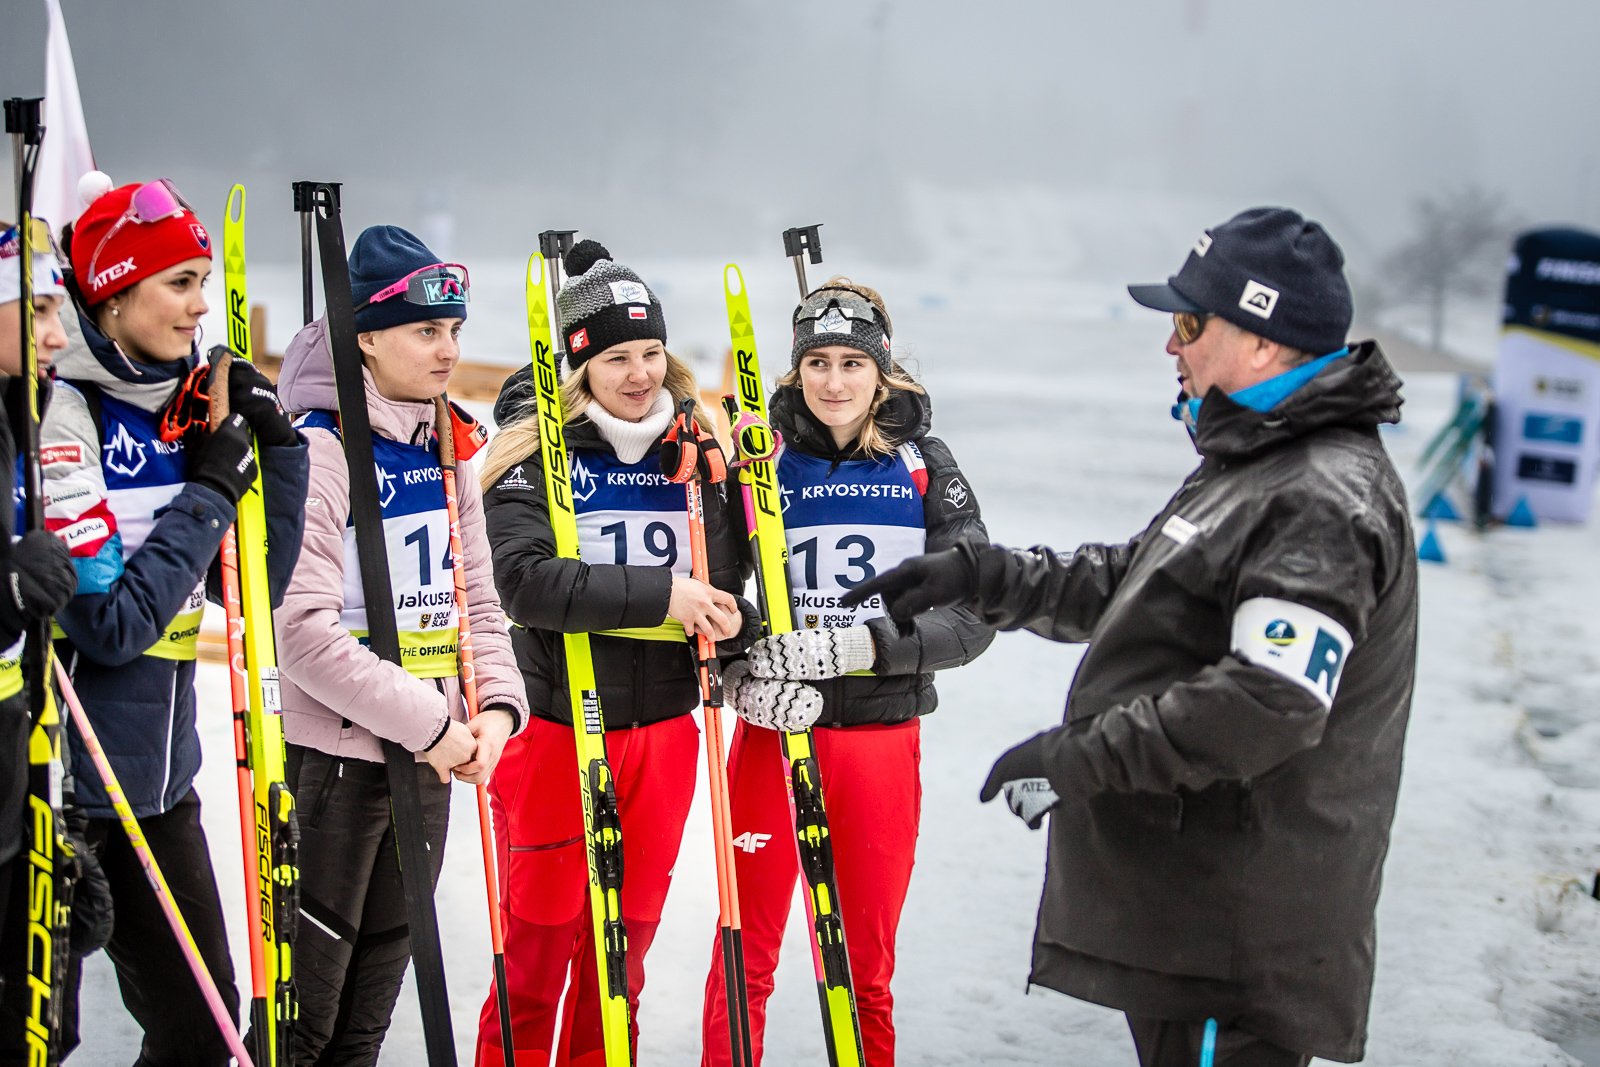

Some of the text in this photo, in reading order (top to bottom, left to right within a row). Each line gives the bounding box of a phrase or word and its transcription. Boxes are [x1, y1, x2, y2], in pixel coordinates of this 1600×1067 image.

[535, 339, 571, 514] FISCHER
[403, 466, 443, 486] KRYOS
[607, 472, 671, 486] KRYOSYS
[802, 483, 913, 500] KRYOSYSTEM
[69, 523, 105, 540] LAPUA
[601, 520, 678, 568] 19
[792, 534, 877, 591] 13
[396, 590, 457, 610] Jakuszy
[823, 614, 857, 623] DOLNY
[1304, 626, 1344, 698] R
[580, 768, 601, 887] FISCHER
[732, 831, 773, 854] 4F
[256, 801, 272, 943] FISCHER
